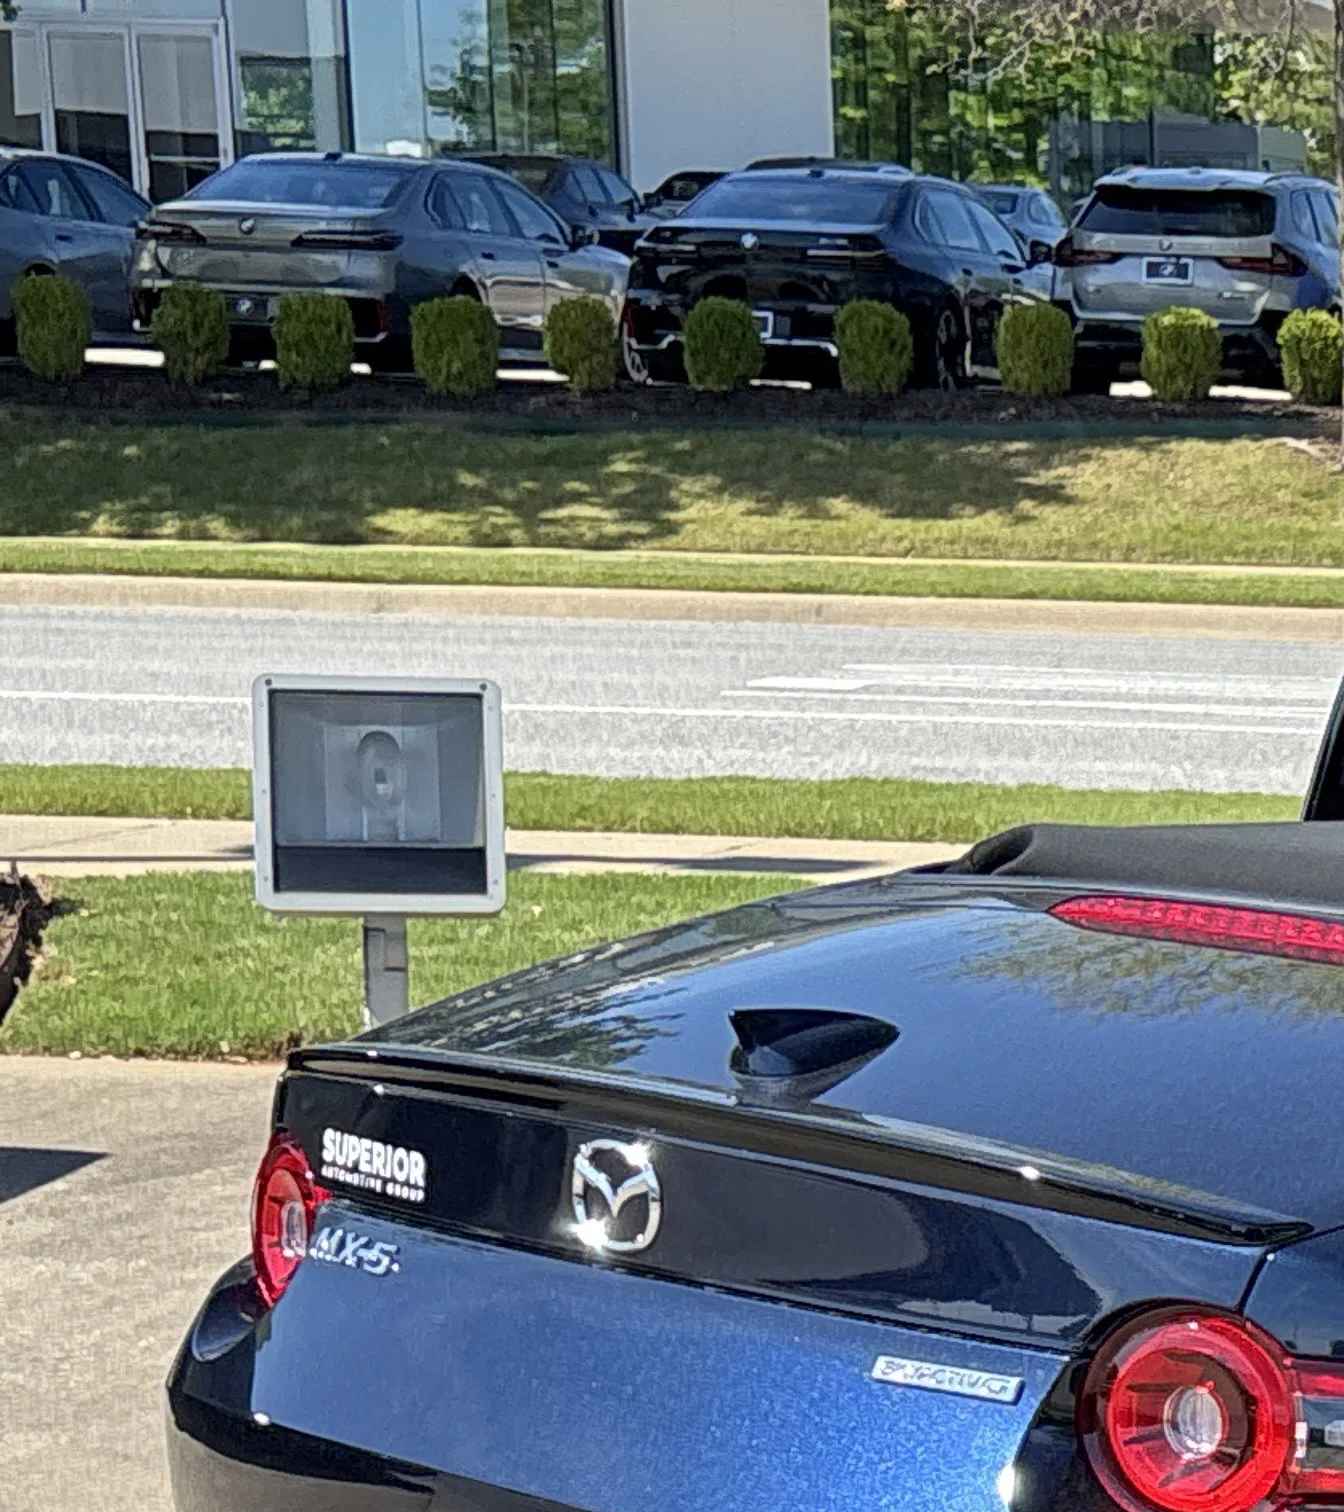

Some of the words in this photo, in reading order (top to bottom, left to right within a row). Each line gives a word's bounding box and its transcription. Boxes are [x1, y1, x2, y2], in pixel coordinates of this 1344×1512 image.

[322, 1128, 425, 1187] SUPERIOR
[321, 1164, 383, 1193] AUTOMOTIVE
[386, 1181, 425, 1202] GROUP
[310, 1227, 399, 1275] MX-5
